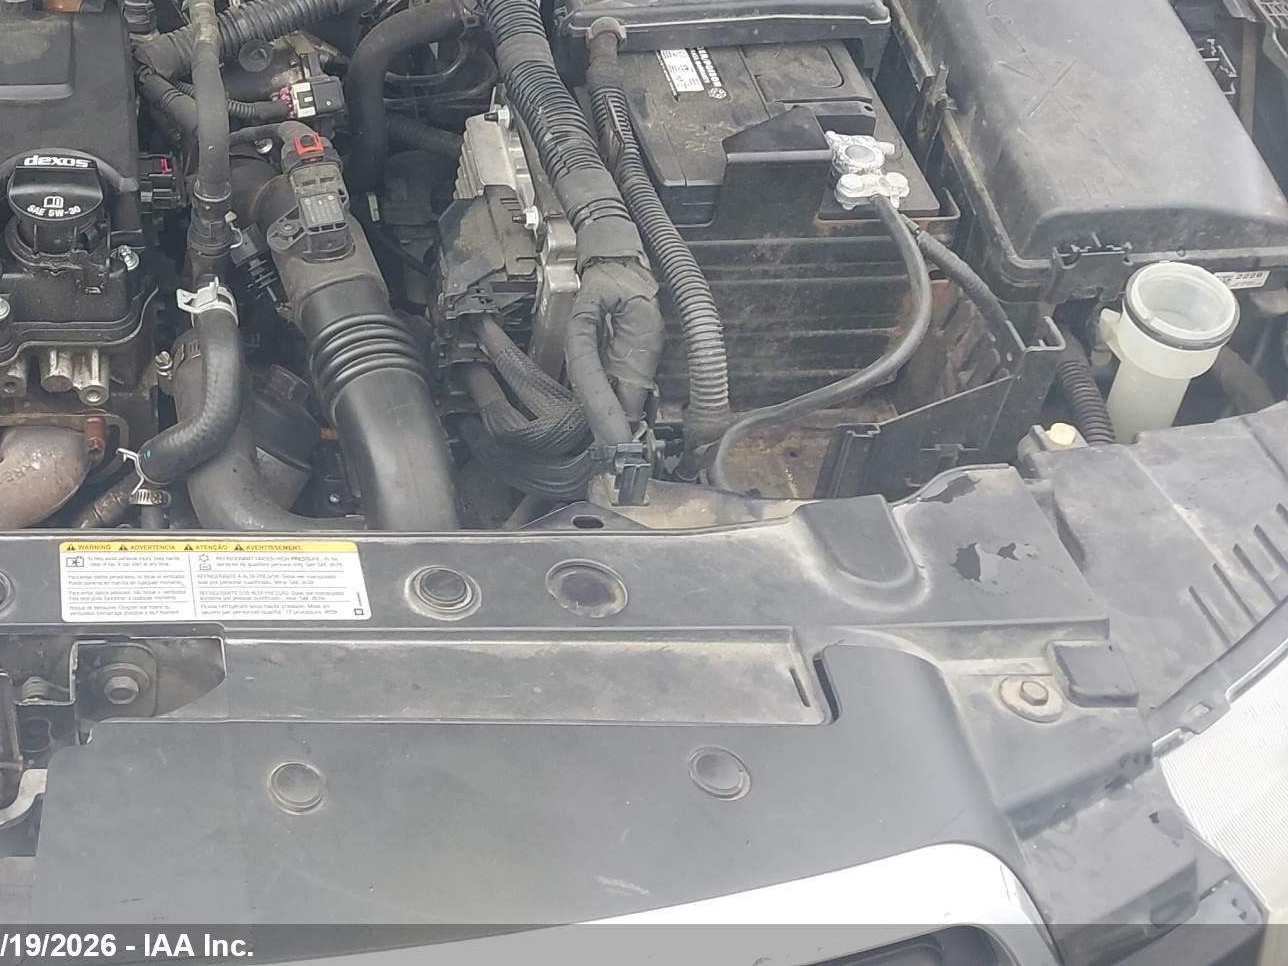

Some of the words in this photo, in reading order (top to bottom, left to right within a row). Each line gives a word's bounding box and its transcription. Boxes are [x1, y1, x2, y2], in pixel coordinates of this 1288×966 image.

[23, 154, 92, 168] dexos
[27, 204, 48, 216] SAE
[48, 205, 82, 218] 5W-30
[195, 543, 228, 551] ATENÇÃO
